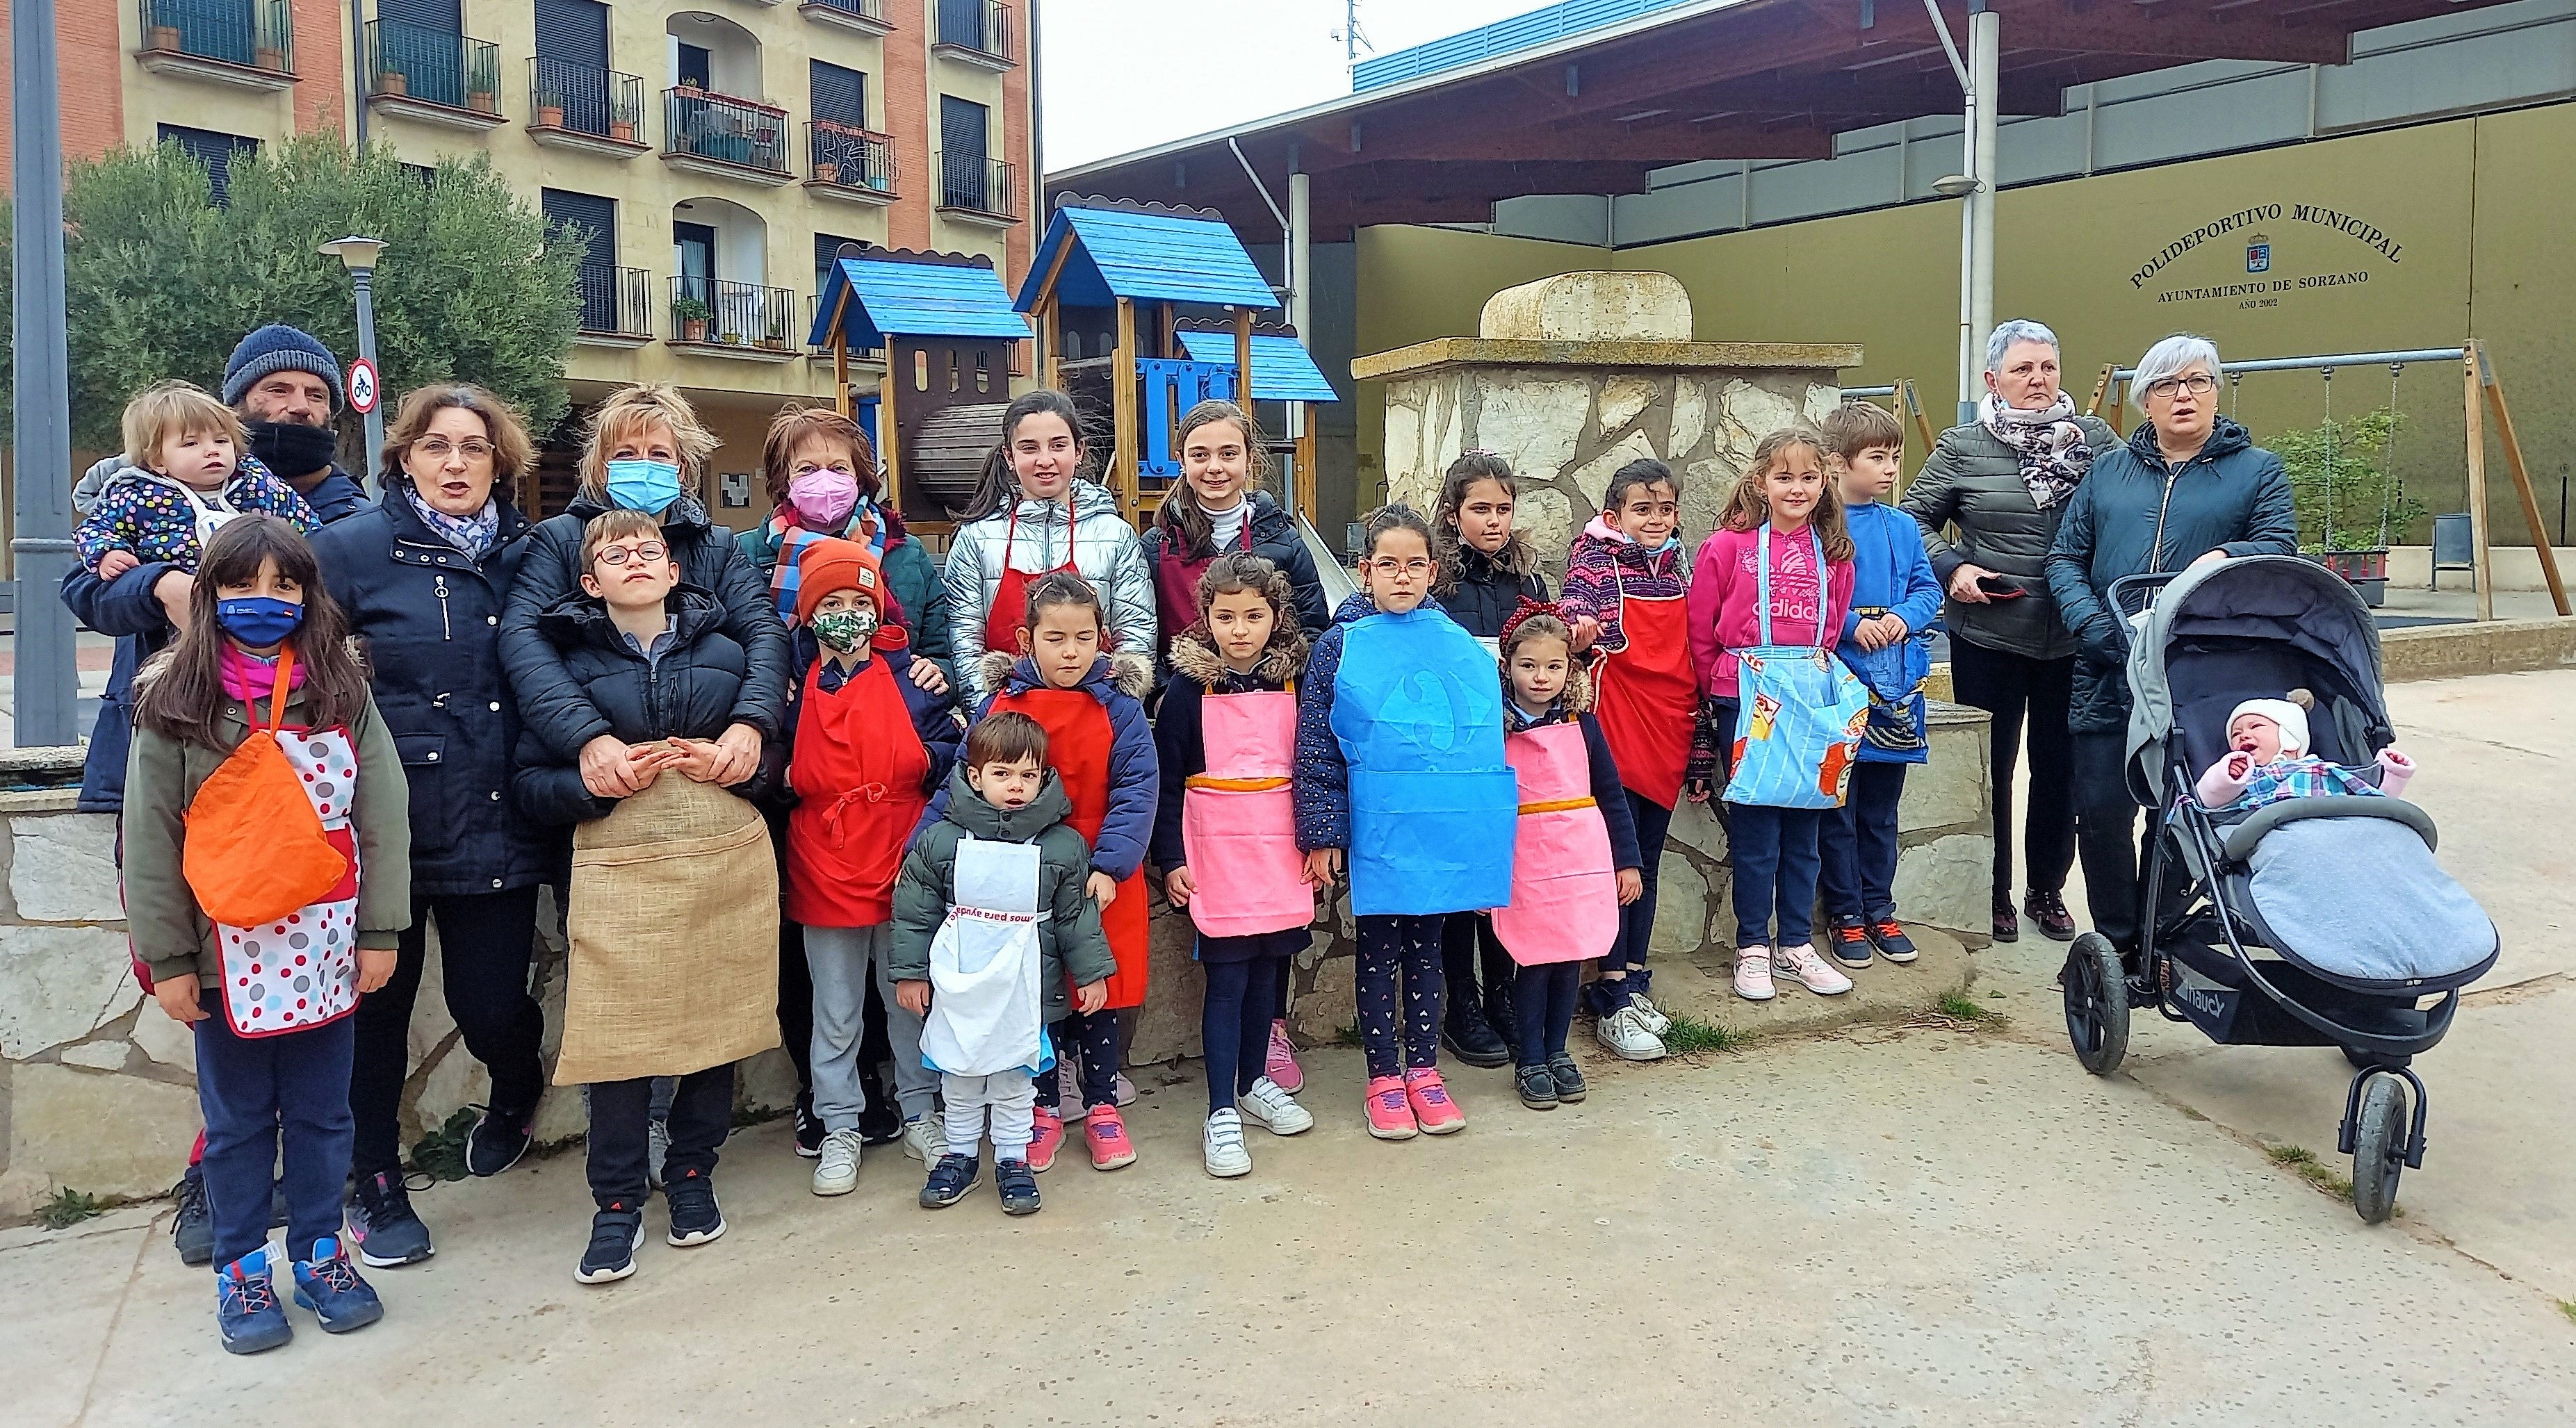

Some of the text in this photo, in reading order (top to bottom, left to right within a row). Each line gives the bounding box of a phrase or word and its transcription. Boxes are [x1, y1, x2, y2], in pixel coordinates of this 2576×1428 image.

[2129, 204, 2403, 289] POLIDEPORTIVO MUNICIPAL
[2157, 271, 2369, 303] AYUNTAMIENTO DE SORZANO
[2238, 298, 2279, 310] AÑO 2002
[984, 912, 1008, 922] para
